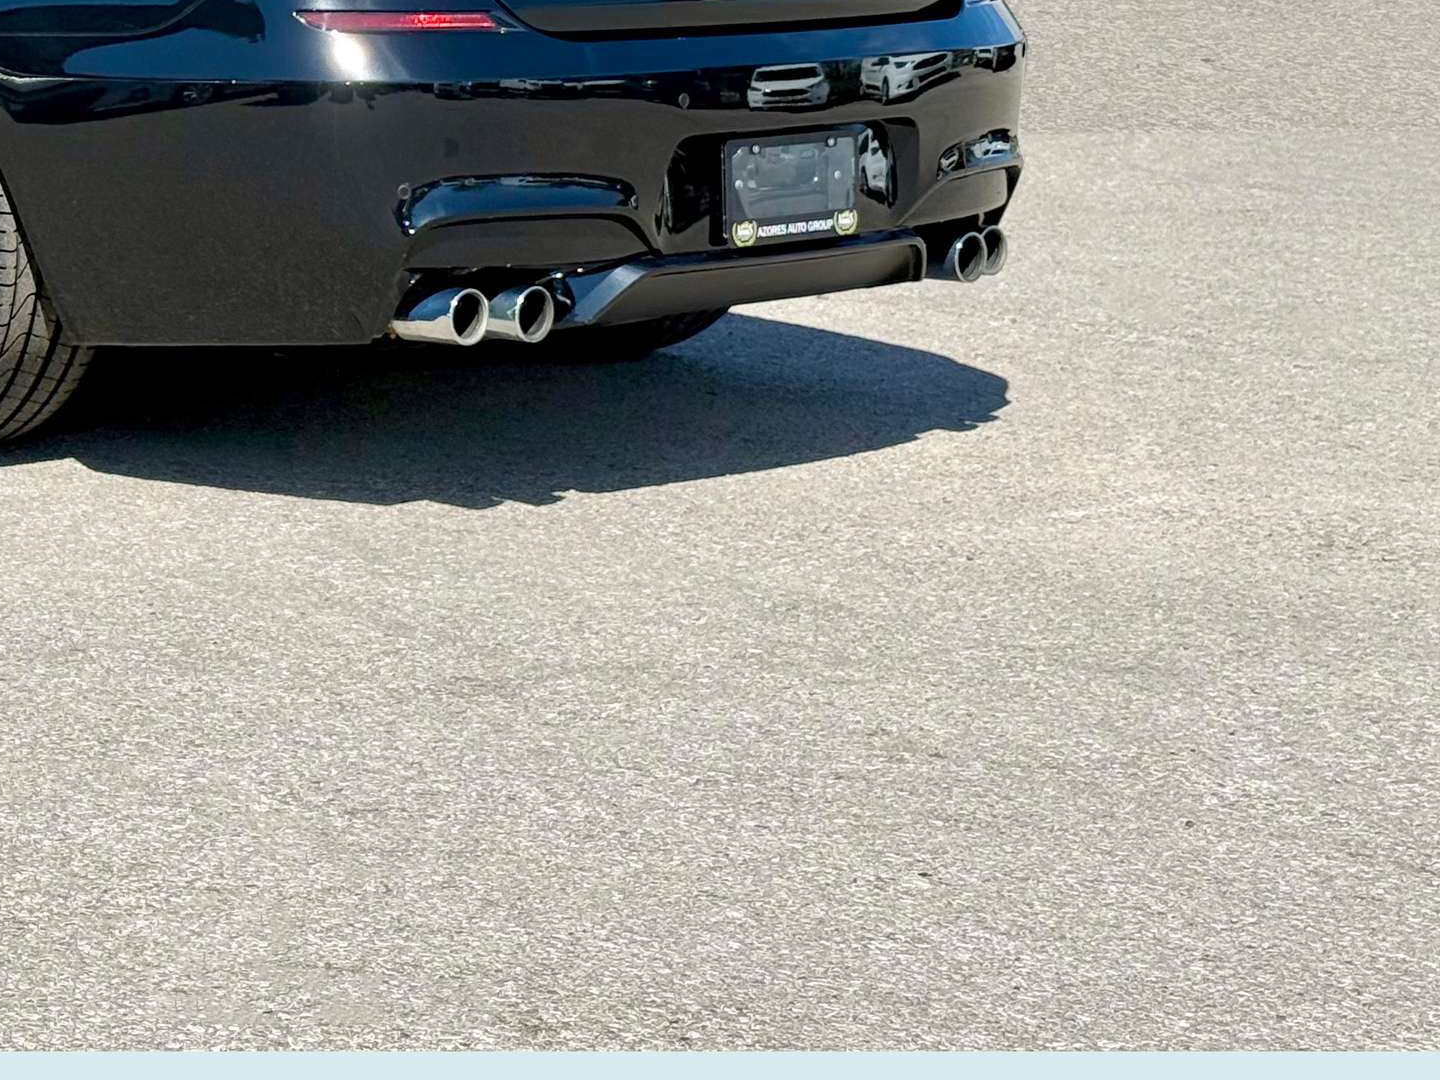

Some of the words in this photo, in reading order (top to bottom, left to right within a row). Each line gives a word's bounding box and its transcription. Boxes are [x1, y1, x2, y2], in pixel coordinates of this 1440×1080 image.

[757, 223, 787, 238] AZORES
[787, 221, 807, 234] AUTO
[807, 219, 833, 232] GROUP
